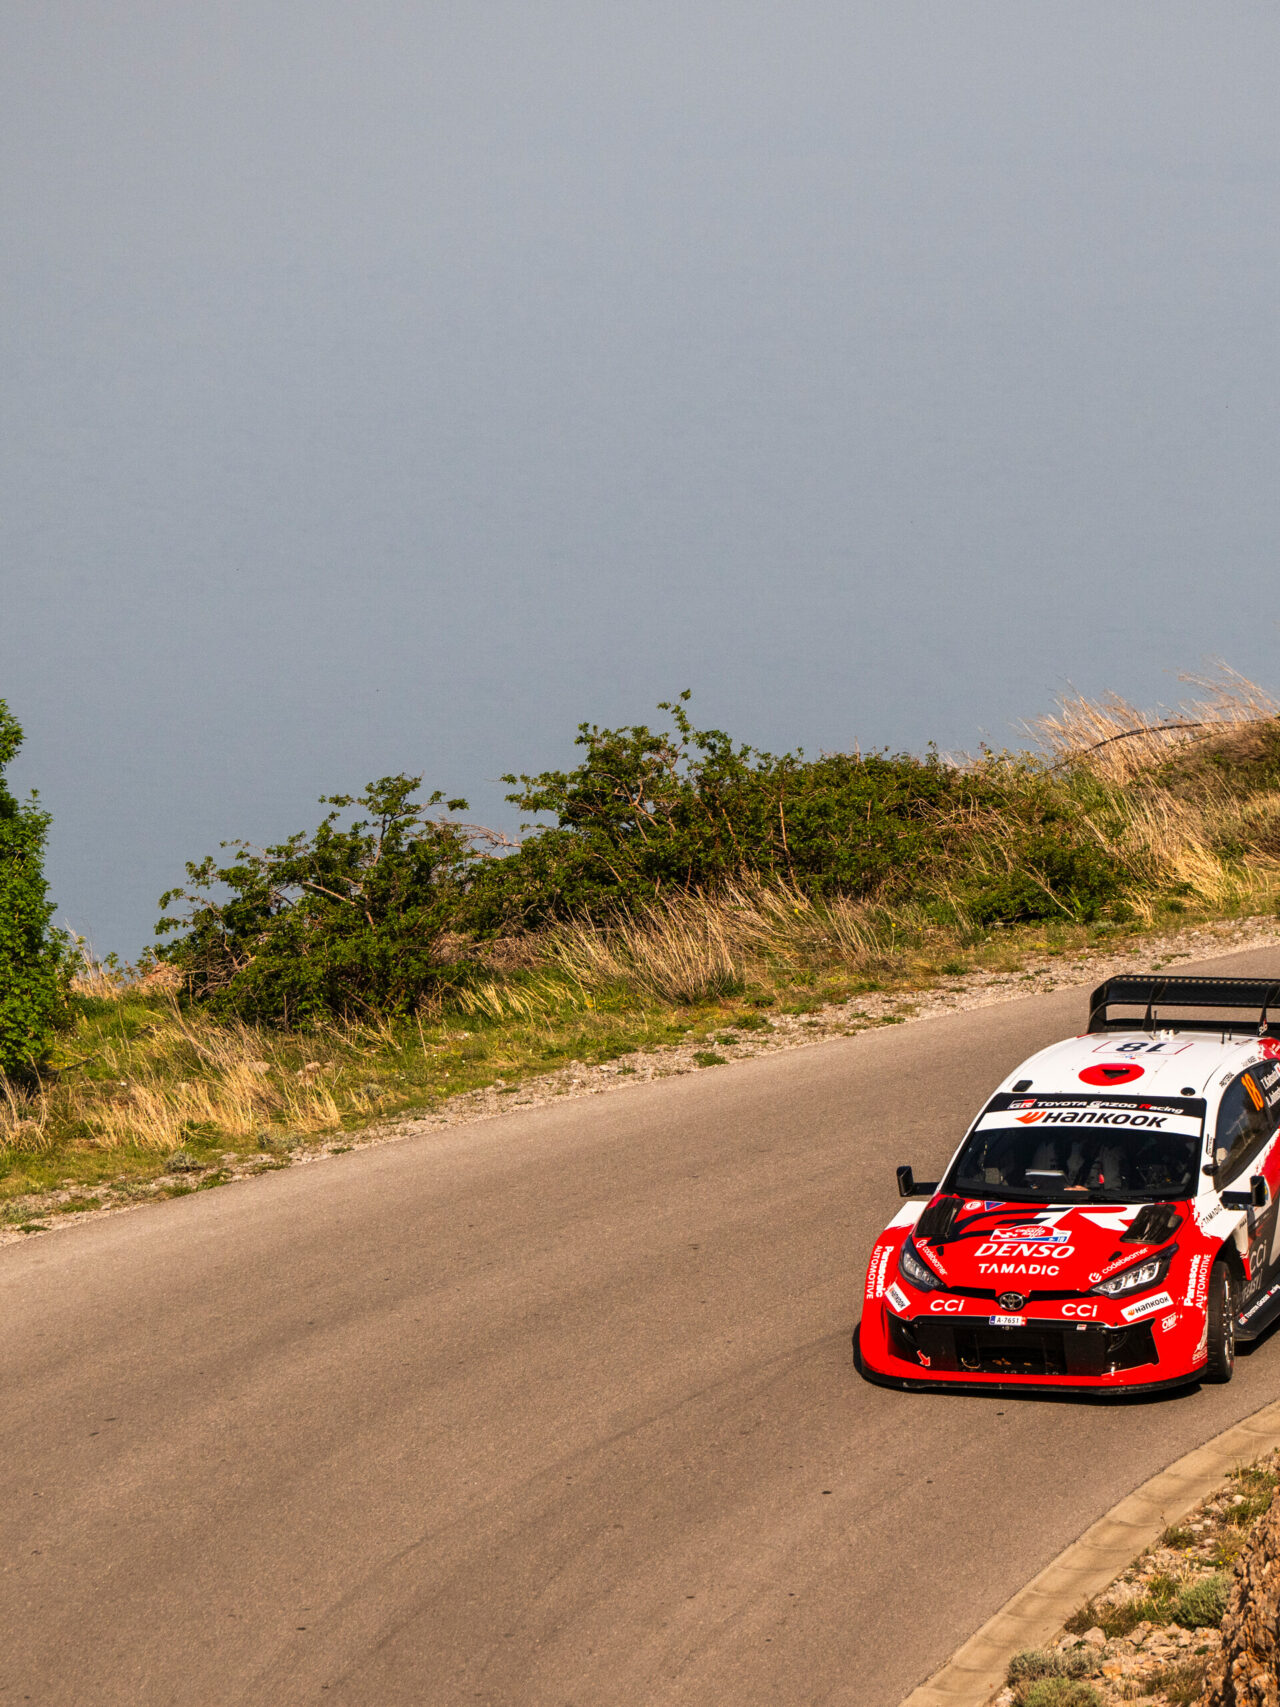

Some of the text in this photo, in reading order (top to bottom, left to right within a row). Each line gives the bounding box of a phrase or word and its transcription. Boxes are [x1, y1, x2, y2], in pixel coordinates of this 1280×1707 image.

[1037, 1101, 1087, 1109] TOYOTA
[1139, 1104, 1184, 1115] Racing
[1241, 1073, 1265, 1112] 18
[974, 1243, 1075, 1259] DENSO
[978, 1263, 1060, 1276] TAMADIC
[1102, 1248, 1148, 1274] codebeamer
[866, 1245, 883, 1299] AUTOMOTIVE
[875, 1245, 894, 1298] Panasonic
[1183, 1254, 1201, 1306] Panasonic
[1195, 1254, 1211, 1309] AUTOMOTIVE
